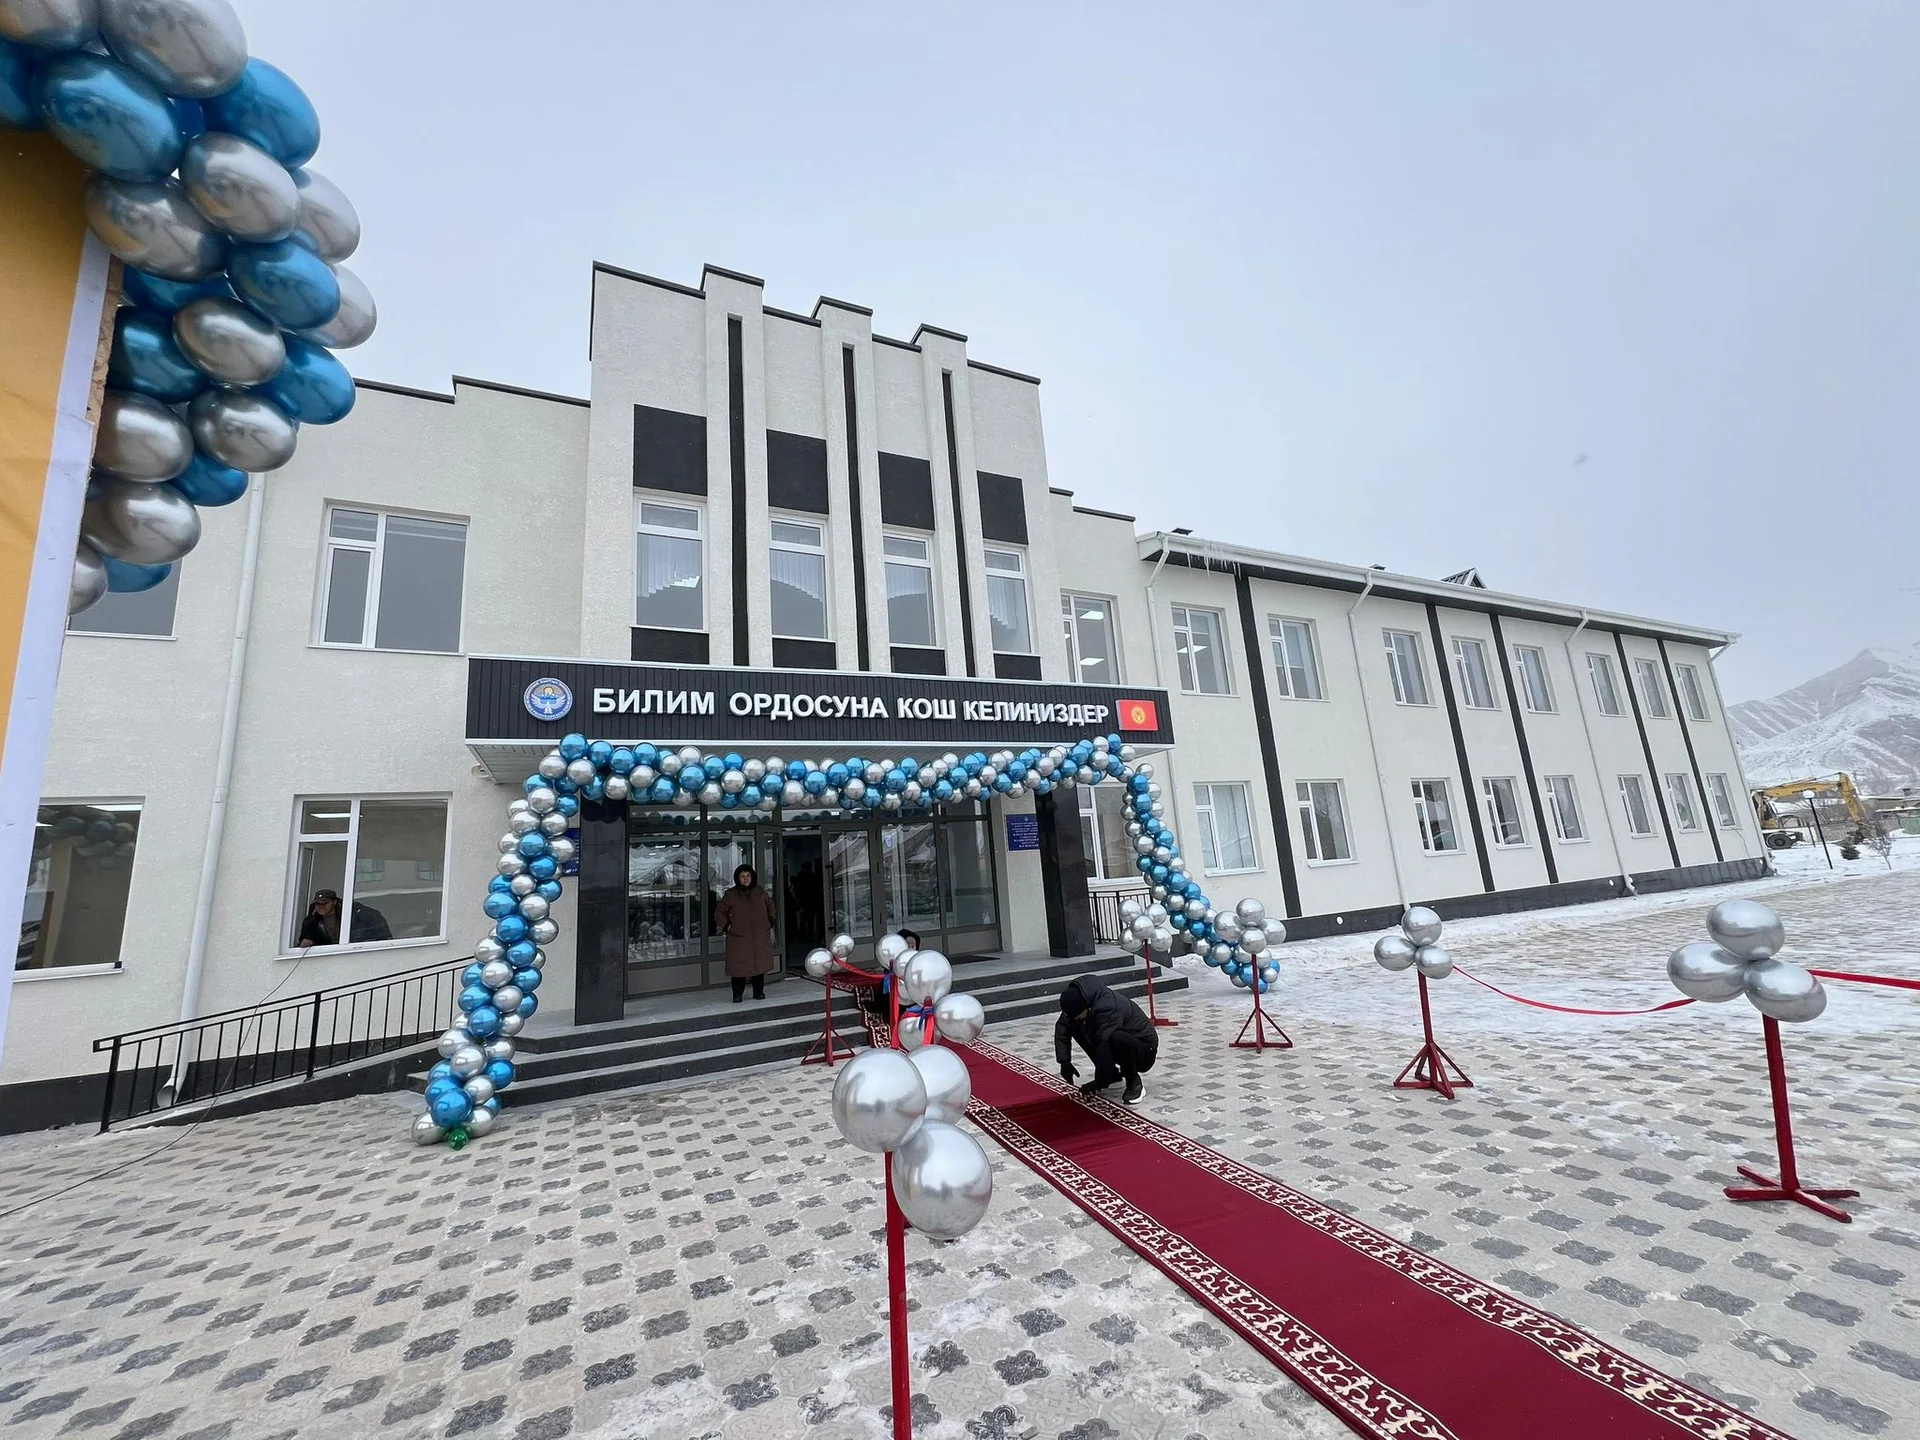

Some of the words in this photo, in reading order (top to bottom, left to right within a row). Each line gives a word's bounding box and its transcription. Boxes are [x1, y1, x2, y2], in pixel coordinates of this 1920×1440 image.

[593, 688, 715, 715] БИЛИМ
[729, 692, 889, 721] ОРДОСУНА
[897, 697, 957, 720] КОШ
[963, 701, 1109, 727] КЕЛИҢИЗДЕР
